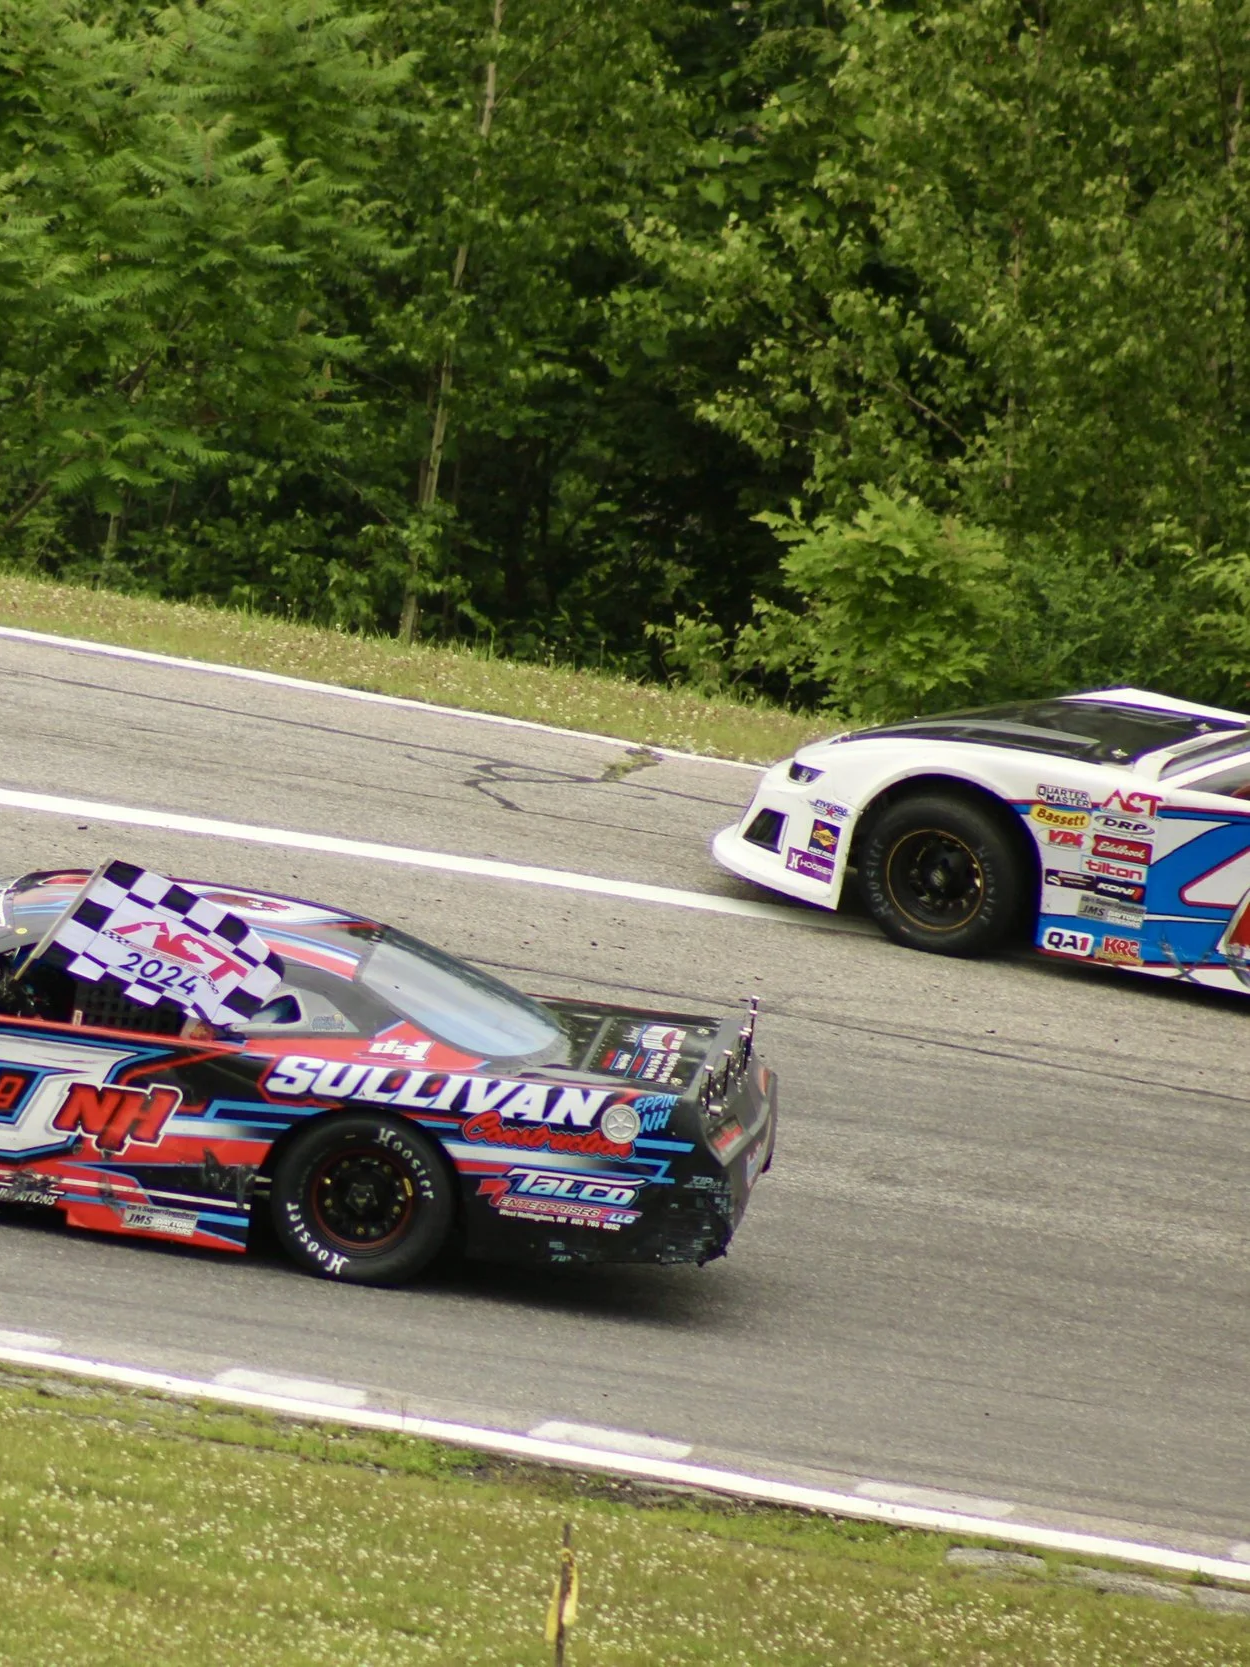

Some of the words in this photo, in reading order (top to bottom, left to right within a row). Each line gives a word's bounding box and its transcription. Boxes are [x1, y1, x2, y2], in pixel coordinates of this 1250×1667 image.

[1037, 786, 1088, 800] QUARTER
[1046, 794, 1090, 807] MASTER
[1036, 808, 1086, 826] Bassett
[1103, 818, 1147, 831] DRP
[1097, 842, 1145, 858] Edelbrock
[800, 859, 832, 875] HOOSIER
[1085, 859, 1143, 880] tilton
[1096, 882, 1135, 895] KONI
[1080, 905, 1106, 916] JMS
[1048, 931, 1090, 951] QA1
[1103, 937, 1139, 958] KRC
[118, 952, 199, 996] 2024
[265, 1055, 615, 1127] SULLIVAN
[52, 1082, 180, 1152] NH
[639, 1109, 672, 1134] NH
[464, 1110, 635, 1160] Construction
[375, 1127, 434, 1199] Hoosier
[128, 1214, 154, 1225] JMS
[498, 1197, 600, 1217] ENTERPRISES
[608, 1212, 636, 1224] LLC
[286, 1202, 350, 1275] Hoosier
